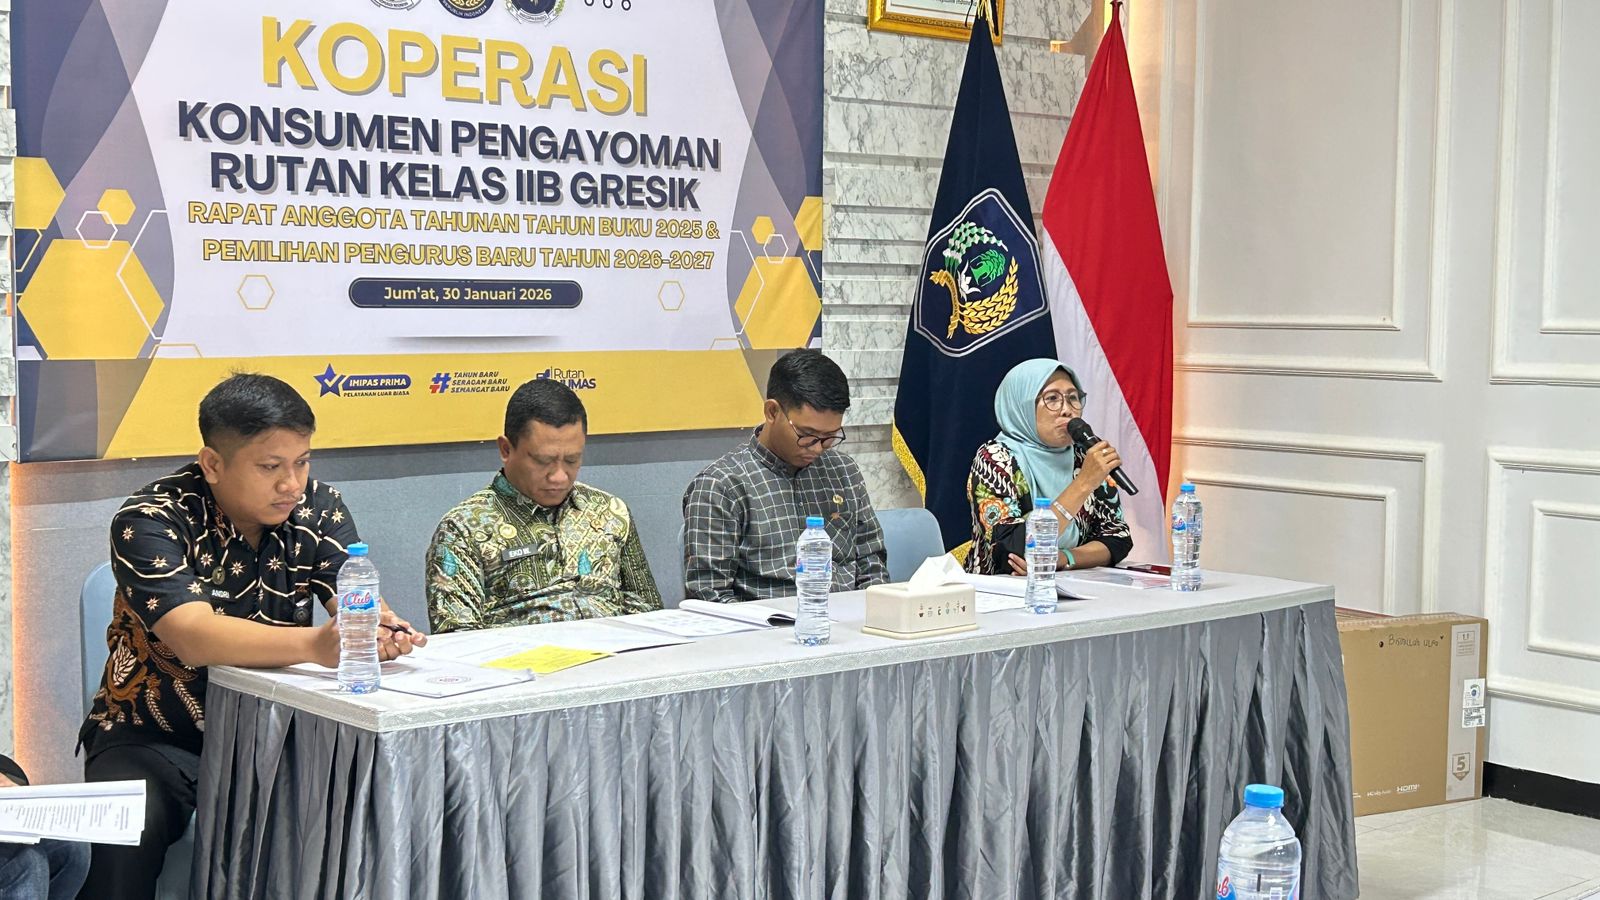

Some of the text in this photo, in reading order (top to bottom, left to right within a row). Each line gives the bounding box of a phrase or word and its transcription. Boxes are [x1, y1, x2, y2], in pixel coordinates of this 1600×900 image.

[262, 16, 648, 115] KOPERASI
[178, 100, 720, 170] KONSUMEN PENGAYOMAN
[210, 152, 701, 210] RUTAN KELAS IIB GRESIK
[188, 201, 720, 239] RAPAT ANGGOTA TAHUNAN TAHUN BUKU 2025 &
[203, 239, 714, 270] PEMILIHAN PENGURUS BARU TAHUN 2026-2027
[384, 287, 552, 301] Jum'at, 30 Januari 2026
[554, 368, 585, 379] Rutan
[349, 378, 407, 387] IMIPAS PRIMA
[560, 378, 597, 389] UMAS
[211, 589, 230, 599] ANDRI
[344, 592, 370, 606] Club
[1456, 756, 1466, 772] 5
